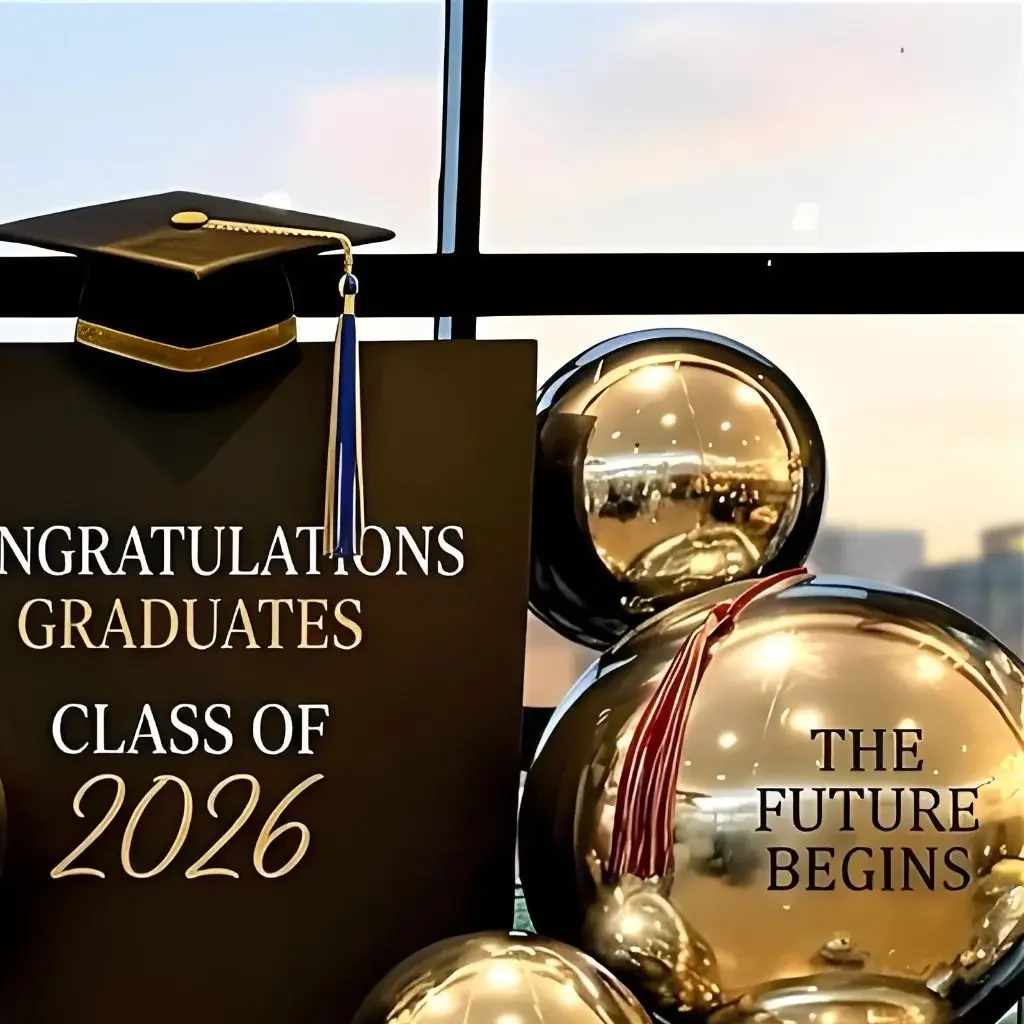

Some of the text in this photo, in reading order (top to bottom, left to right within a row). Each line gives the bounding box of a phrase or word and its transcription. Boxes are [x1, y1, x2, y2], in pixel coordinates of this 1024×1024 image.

[18, 598, 363, 650] GRADUATES
[51, 702, 330, 755] CLASS OF
[810, 728, 924, 772] THE
[49, 773, 325, 879] 2026
[754, 787, 980, 832] FUTURE
[766, 846, 971, 892] BEGINS
